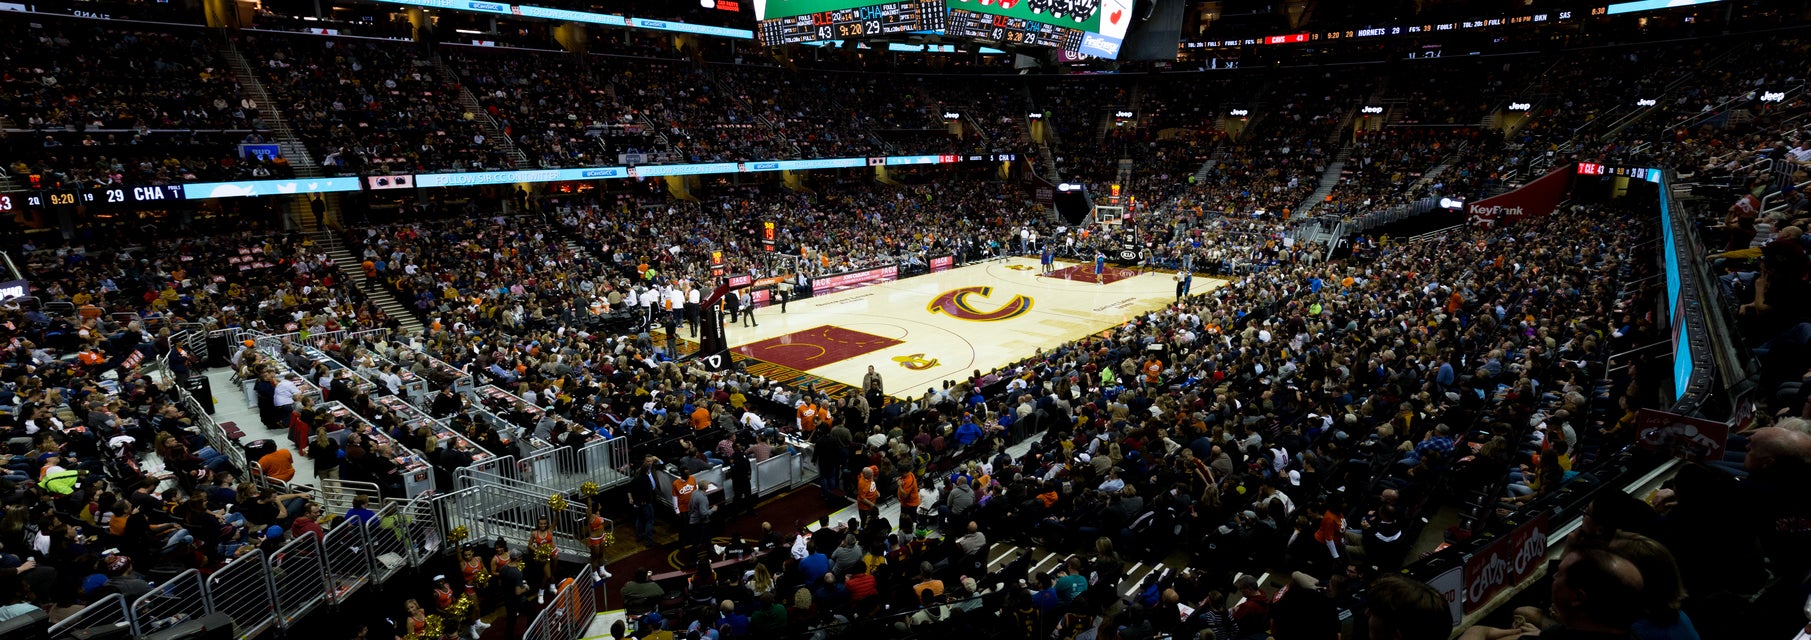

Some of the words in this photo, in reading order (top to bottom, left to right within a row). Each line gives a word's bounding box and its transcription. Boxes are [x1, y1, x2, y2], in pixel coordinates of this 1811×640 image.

[813, 11, 834, 26] CLE
[861, 6, 881, 20] CHA
[865, 20, 880, 35] 29
[993, 15, 1008, 28] CLE
[1026, 20, 1040, 32] CHA
[1358, 28, 1386, 38] HORNETS
[1391, 27, 1400, 35] 29
[1534, 14, 1548, 22] BKN
[1559, 11, 1571, 20] SAS
[818, 25, 832, 39] 43
[992, 27, 1003, 40] 43
[1023, 32, 1036, 44] 29
[1271, 36, 1286, 44] CAVS
[1637, 98, 1656, 107] Jeep
[1761, 91, 1784, 102] Jeep
[1362, 106, 1383, 114] Jeep
[1509, 102, 1530, 111] Jeep
[944, 112, 960, 120] Jeep
[1116, 110, 1133, 119] Jeep
[1230, 109, 1248, 117] Jeep
[1584, 163, 1595, 174] CLE
[1597, 165, 1604, 175] 43
[435, 173, 475, 185] FOLLOW
[477, 172, 492, 183] SIR
[494, 172, 506, 182] CC
[51, 193, 74, 205] 9:20
[83, 193, 94, 202] 19
[106, 189, 124, 203] 29
[134, 186, 164, 201] CHA
[173, 189, 179, 199] 1
[881, 266, 898, 275] JACK
[731, 276, 748, 284] JACK
[812, 279, 831, 288] JACK
[1514, 526, 1547, 575] CAVS
[1469, 552, 1507, 603] CAVS
